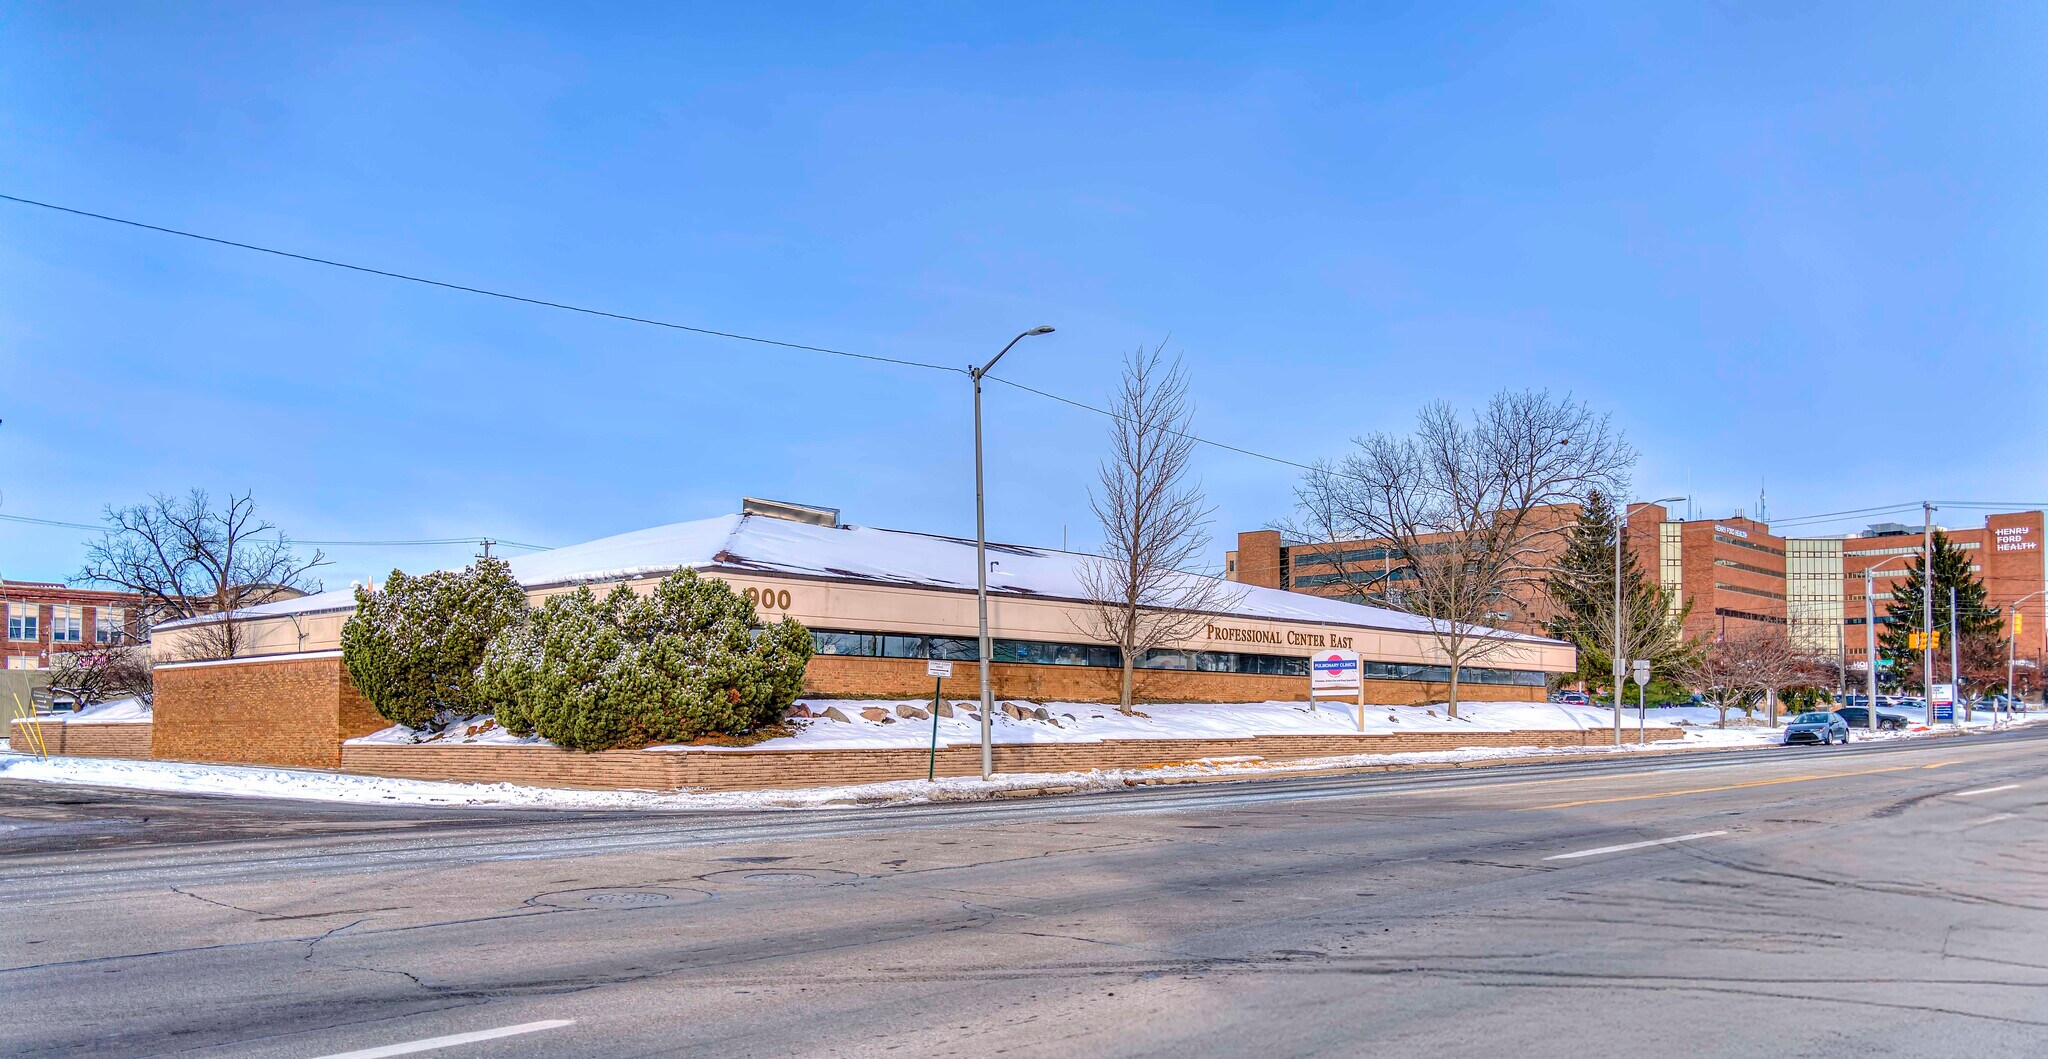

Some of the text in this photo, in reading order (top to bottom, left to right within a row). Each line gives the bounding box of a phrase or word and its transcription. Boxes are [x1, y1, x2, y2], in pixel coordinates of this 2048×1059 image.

[1995, 527, 2029, 535] HENRY
[1997, 535, 2022, 543] FORD
[1997, 542, 2037, 551] HEALTH
[747, 587, 791, 610] 900
[1207, 624, 1353, 649] PROFESSIONAL CENTER EAST
